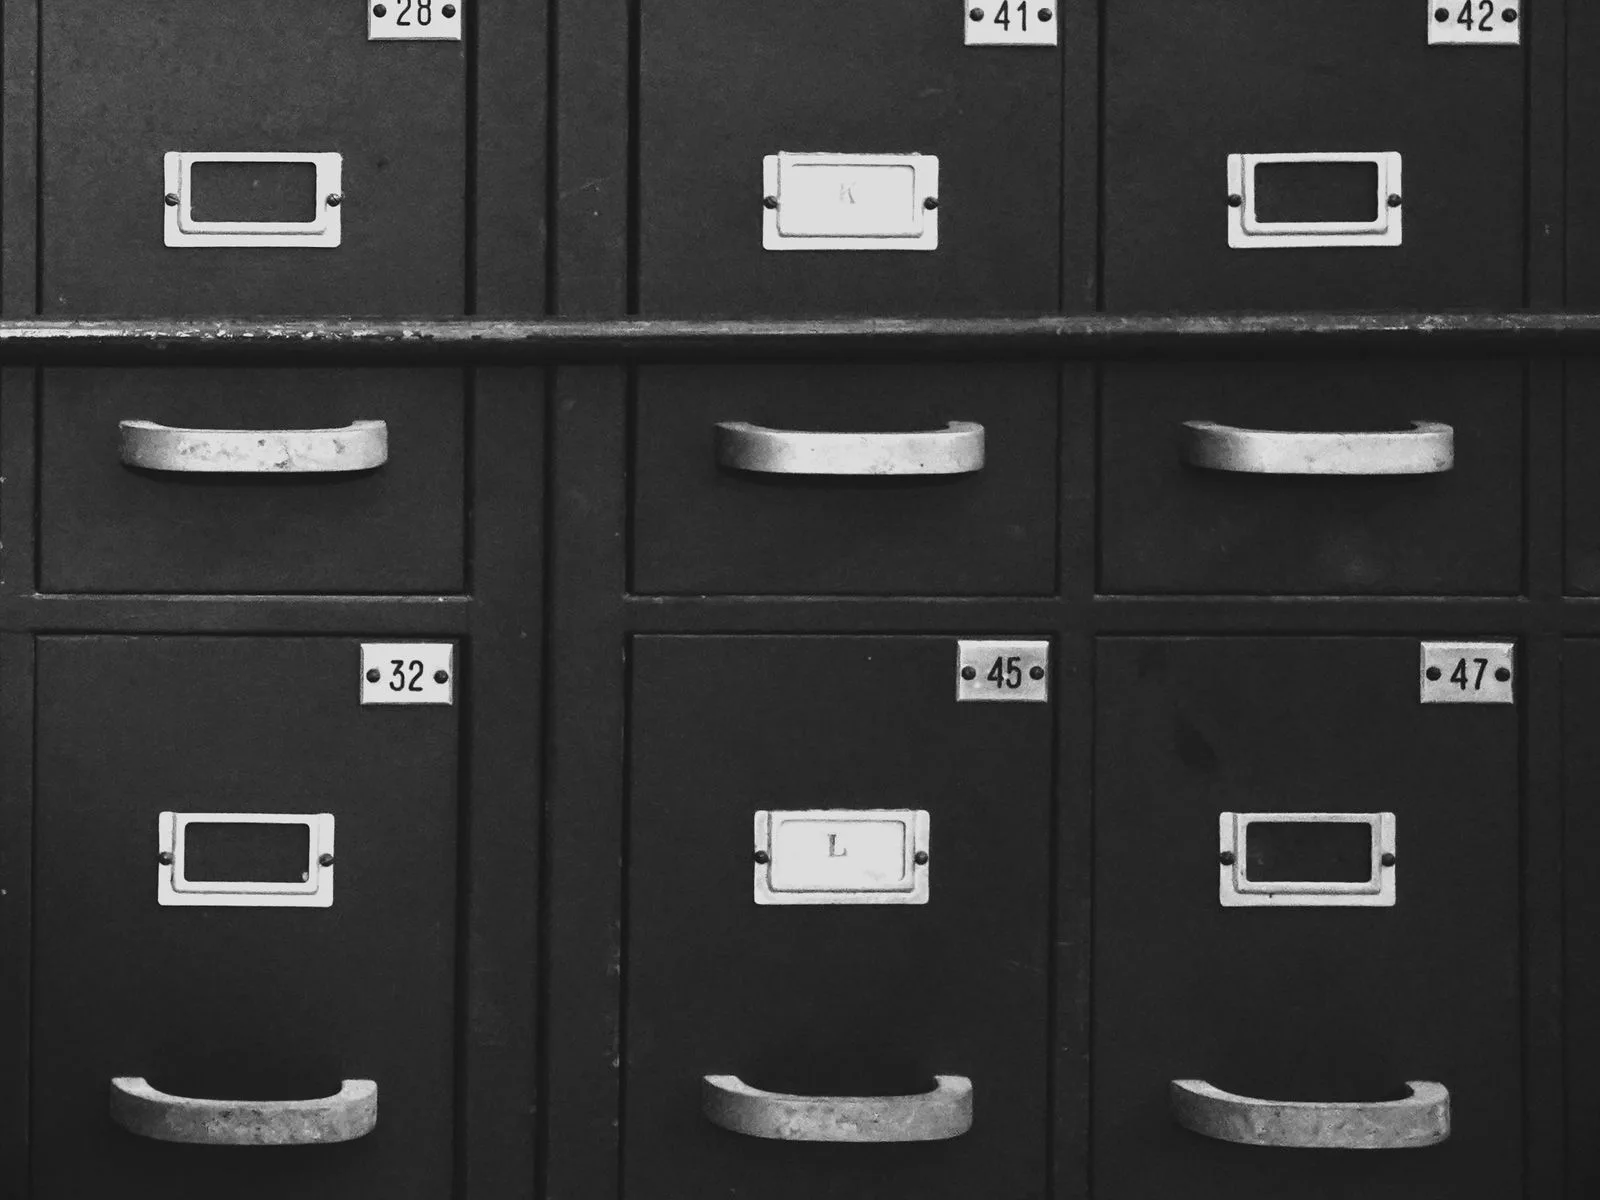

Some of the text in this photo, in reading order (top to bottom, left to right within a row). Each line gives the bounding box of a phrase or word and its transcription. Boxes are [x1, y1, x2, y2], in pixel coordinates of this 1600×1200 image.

[993, 0, 1027, 32] 41
[390, 659, 423, 692] 32
[986, 656, 1022, 689] 45
[1450, 657, 1488, 691] 47
[826, 832, 849, 858] L
